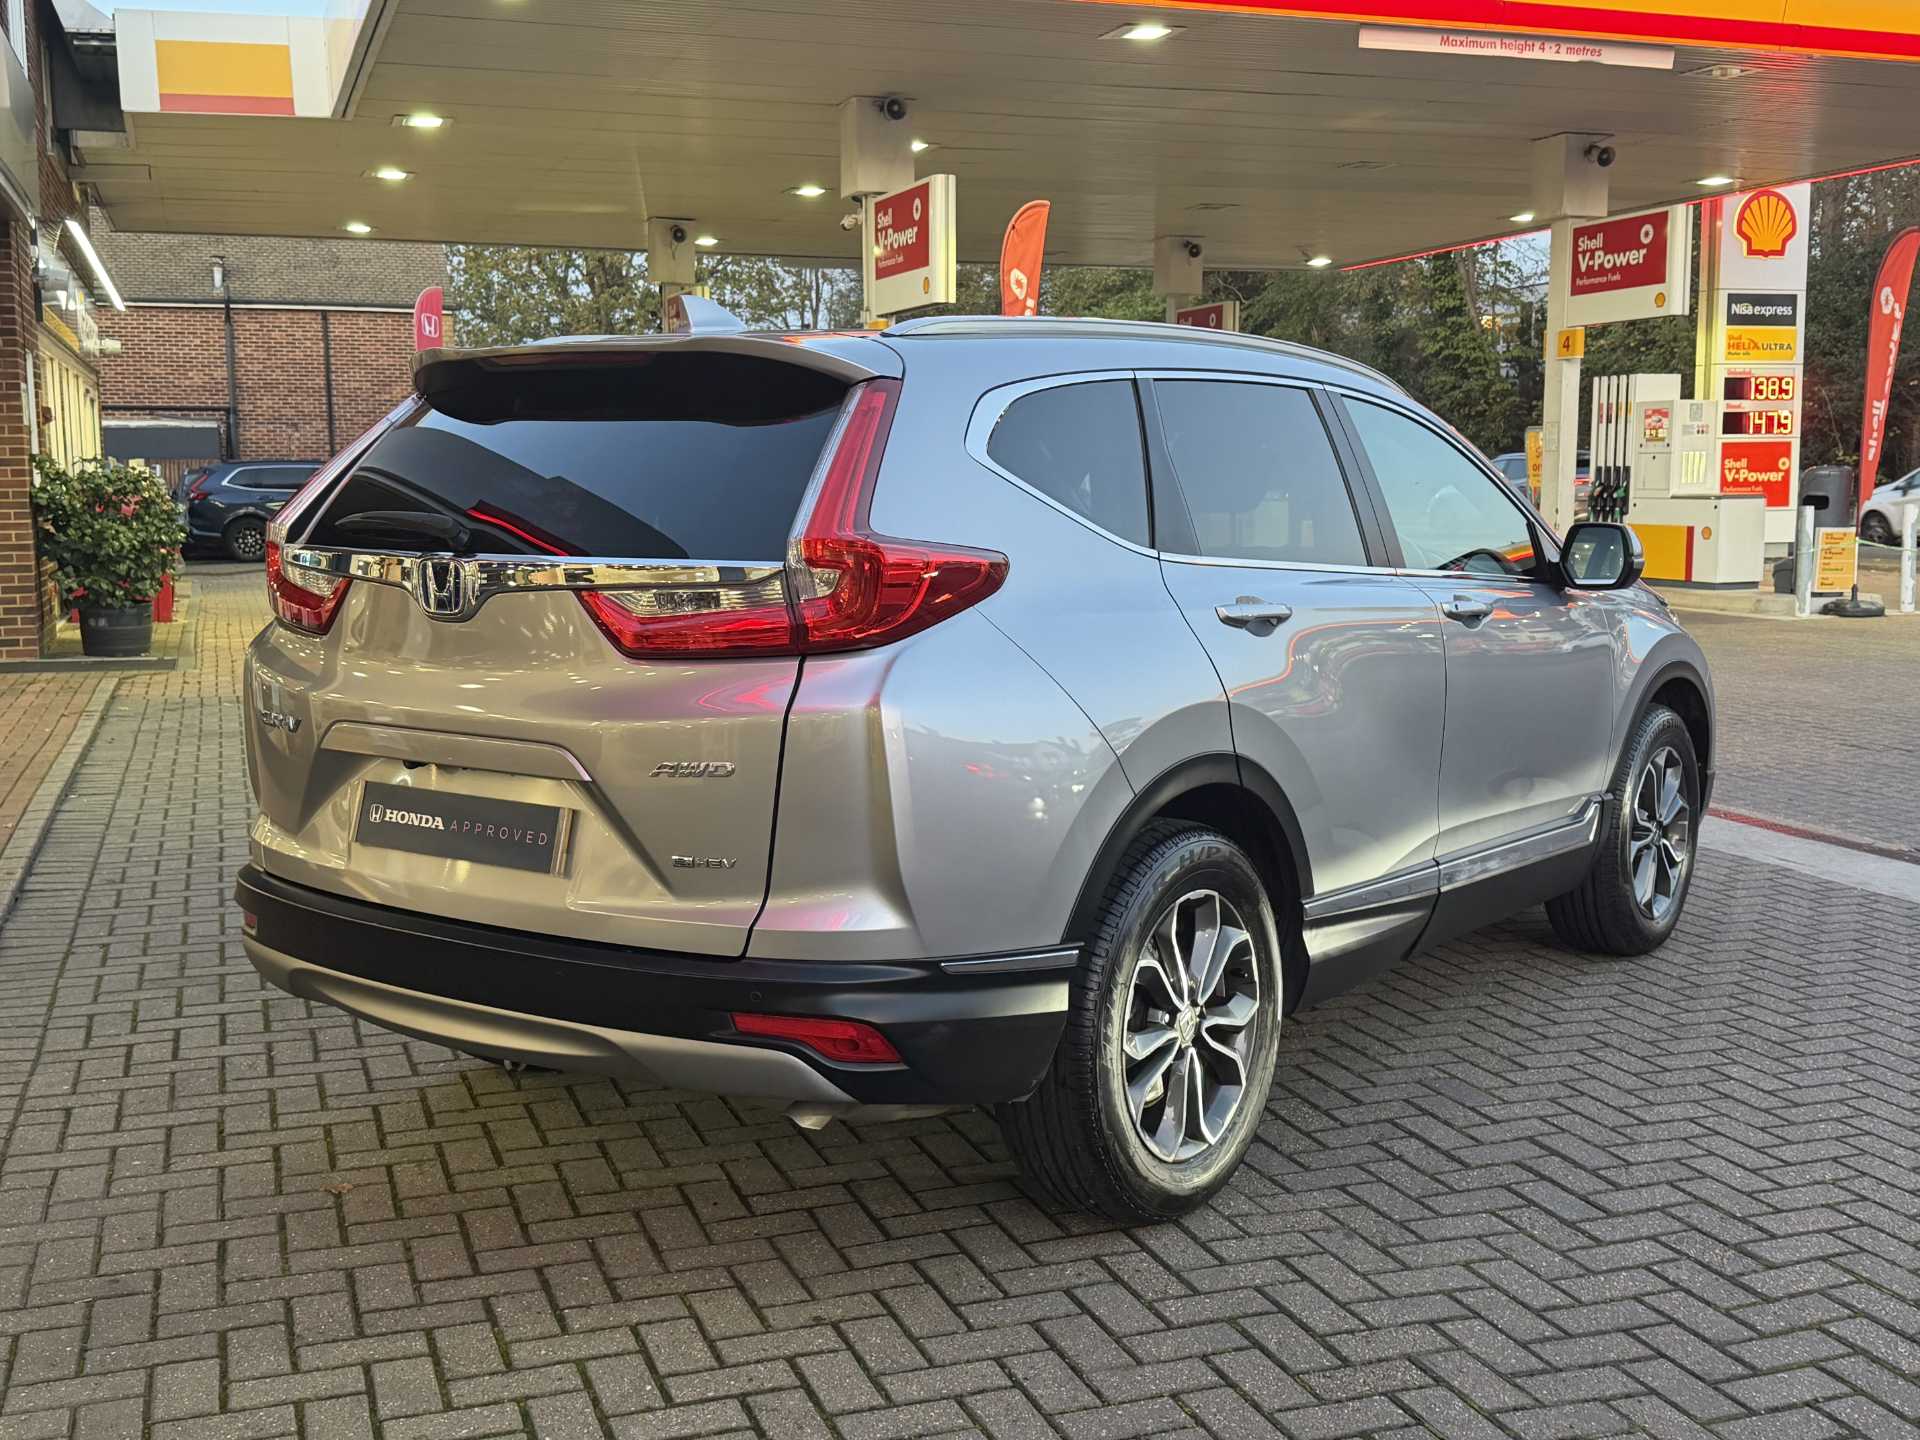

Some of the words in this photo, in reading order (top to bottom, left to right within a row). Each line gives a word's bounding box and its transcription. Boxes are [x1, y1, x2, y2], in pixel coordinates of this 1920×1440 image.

[1440, 35, 1497, 50] Maximum
[1500, 39, 1535, 54] height
[1565, 46, 1603, 57] metres
[1578, 232, 1603, 251] Shell
[1578, 247, 1647, 272] V-Power
[1731, 303, 1753, 315] Nisa
[1753, 305, 1793, 317] express
[1562, 335, 1570, 352] 4
[1761, 342, 1792, 351] ULTRA
[1750, 377, 1794, 400] 138.9
[1749, 410, 1793, 434] 147.9
[1724, 457, 1748, 469] Shell
[1724, 468, 1785, 482] V-Power
[649, 761, 736, 778] AWD
[384, 808, 445, 830] HONDA
[450, 820, 548, 845] APPROVED
